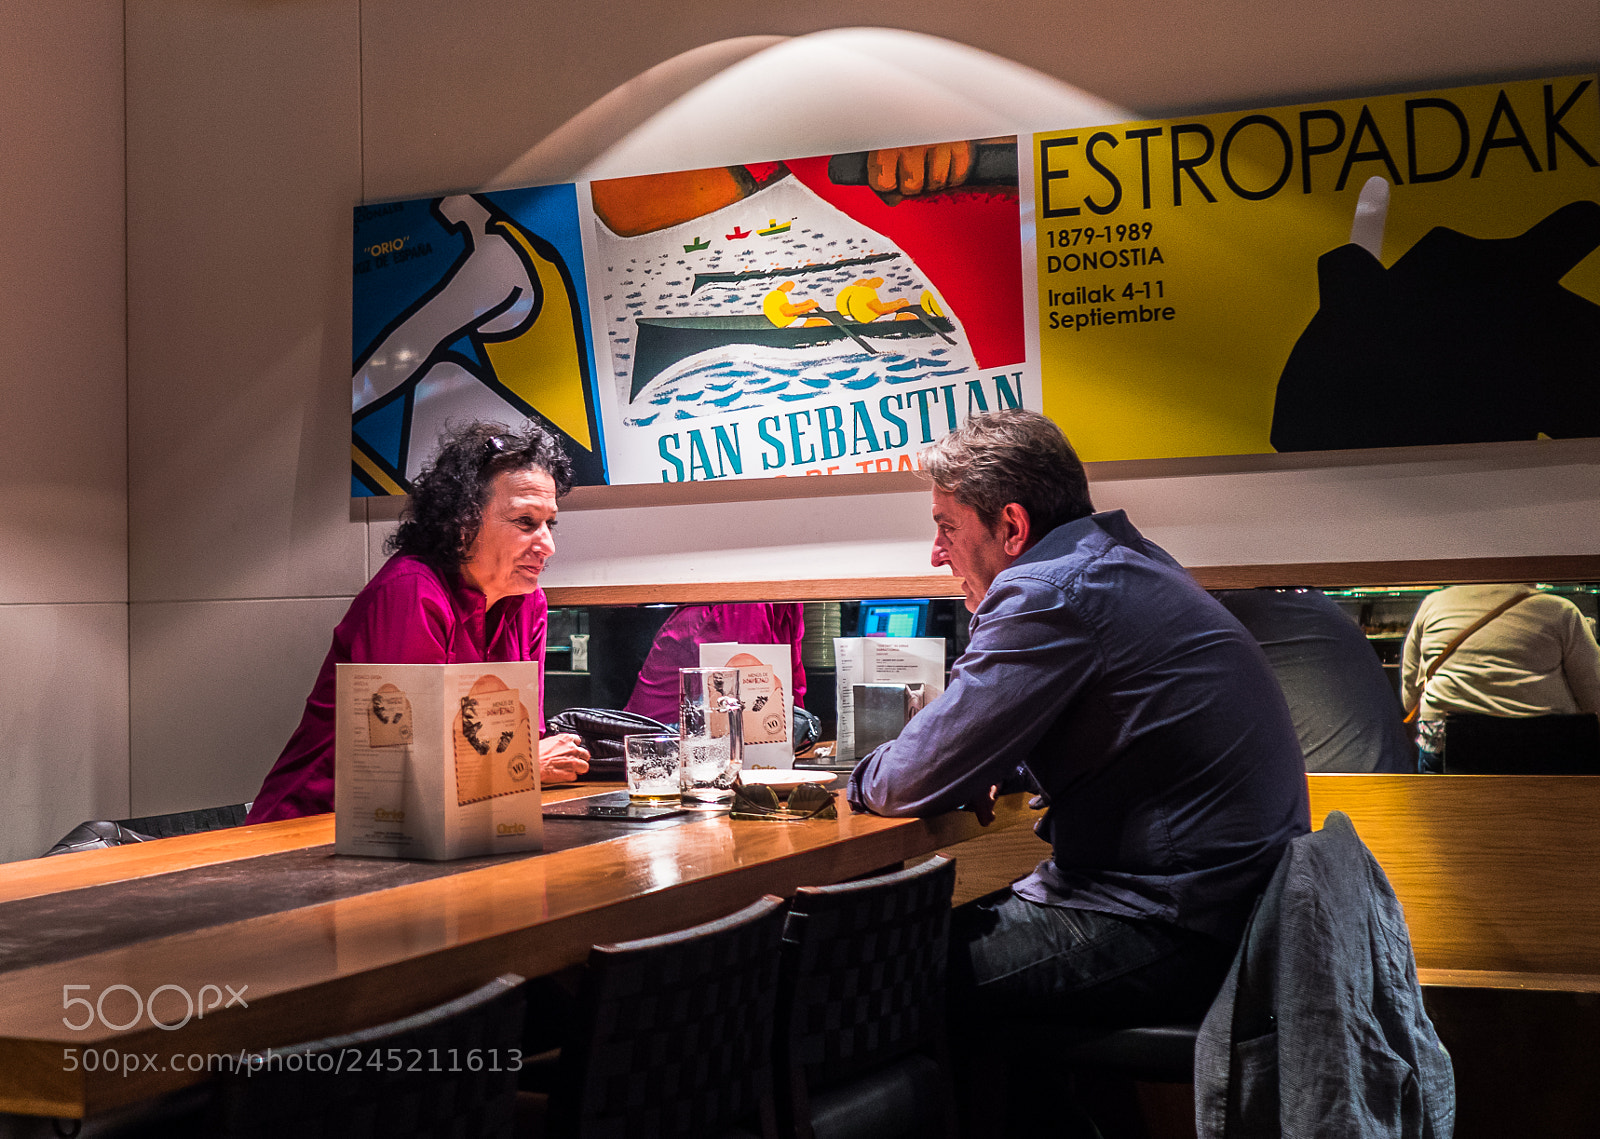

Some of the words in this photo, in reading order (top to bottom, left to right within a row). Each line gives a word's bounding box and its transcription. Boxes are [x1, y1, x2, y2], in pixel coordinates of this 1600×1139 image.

[1041, 79, 1600, 218] ESTROPADAK
[364, 235, 410, 257] "ORIO"
[1047, 222, 1153, 248] 1879-1989
[1047, 247, 1164, 273] DONOSTIA
[1048, 284, 1116, 307] Irailak
[1121, 280, 1164, 300] 4-11
[1049, 304, 1176, 331] Septiembre
[657, 422, 743, 483] SAN
[757, 371, 1023, 471] SEBASTIAN
